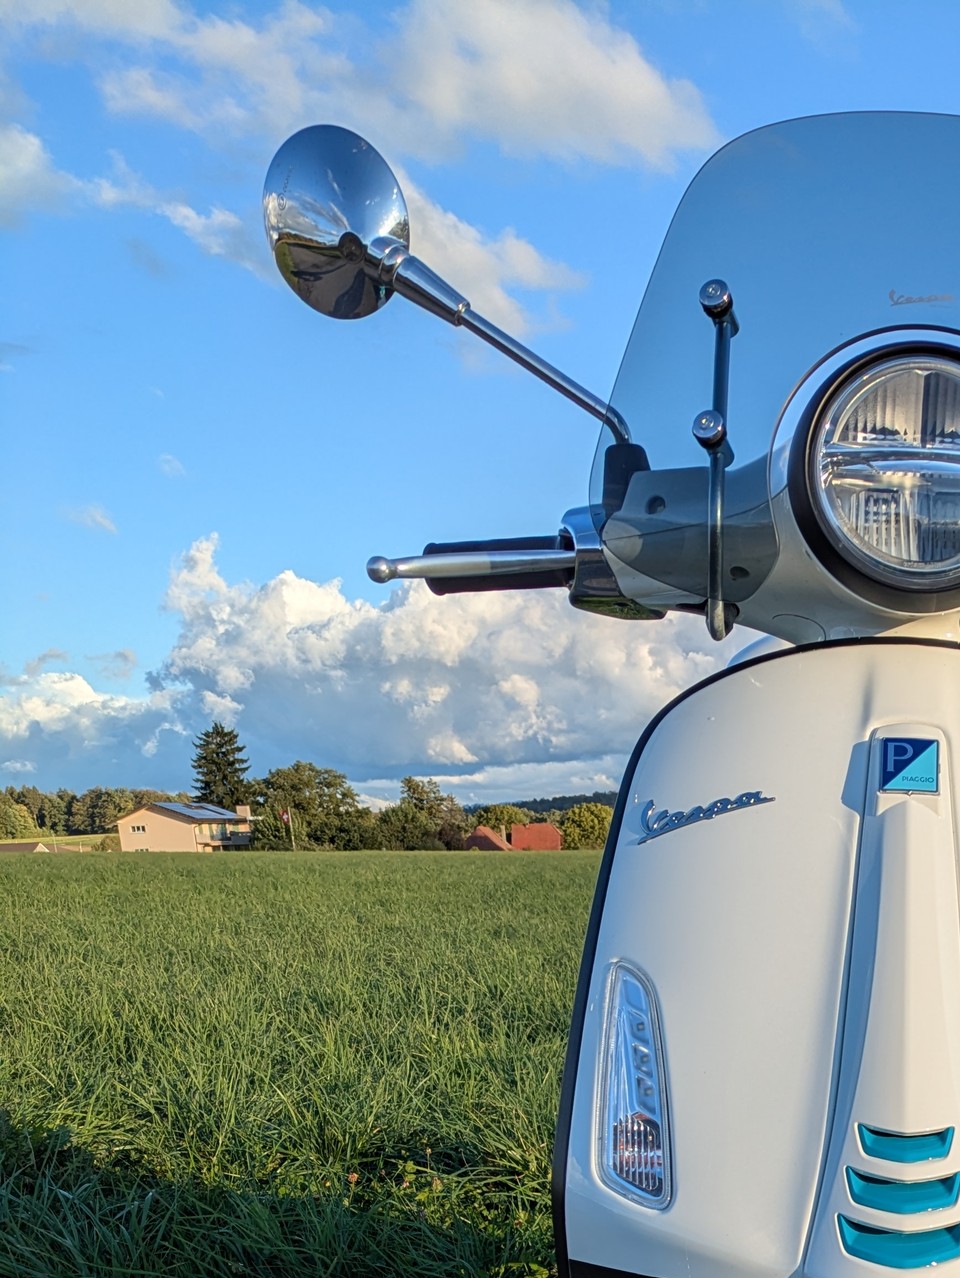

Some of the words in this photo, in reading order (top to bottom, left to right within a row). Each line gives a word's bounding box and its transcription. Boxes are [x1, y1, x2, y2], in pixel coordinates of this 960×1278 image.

[886, 742, 914, 772] P
[901, 775, 935, 783] PIAGGIO
[638, 791, 776, 845] Vespa
